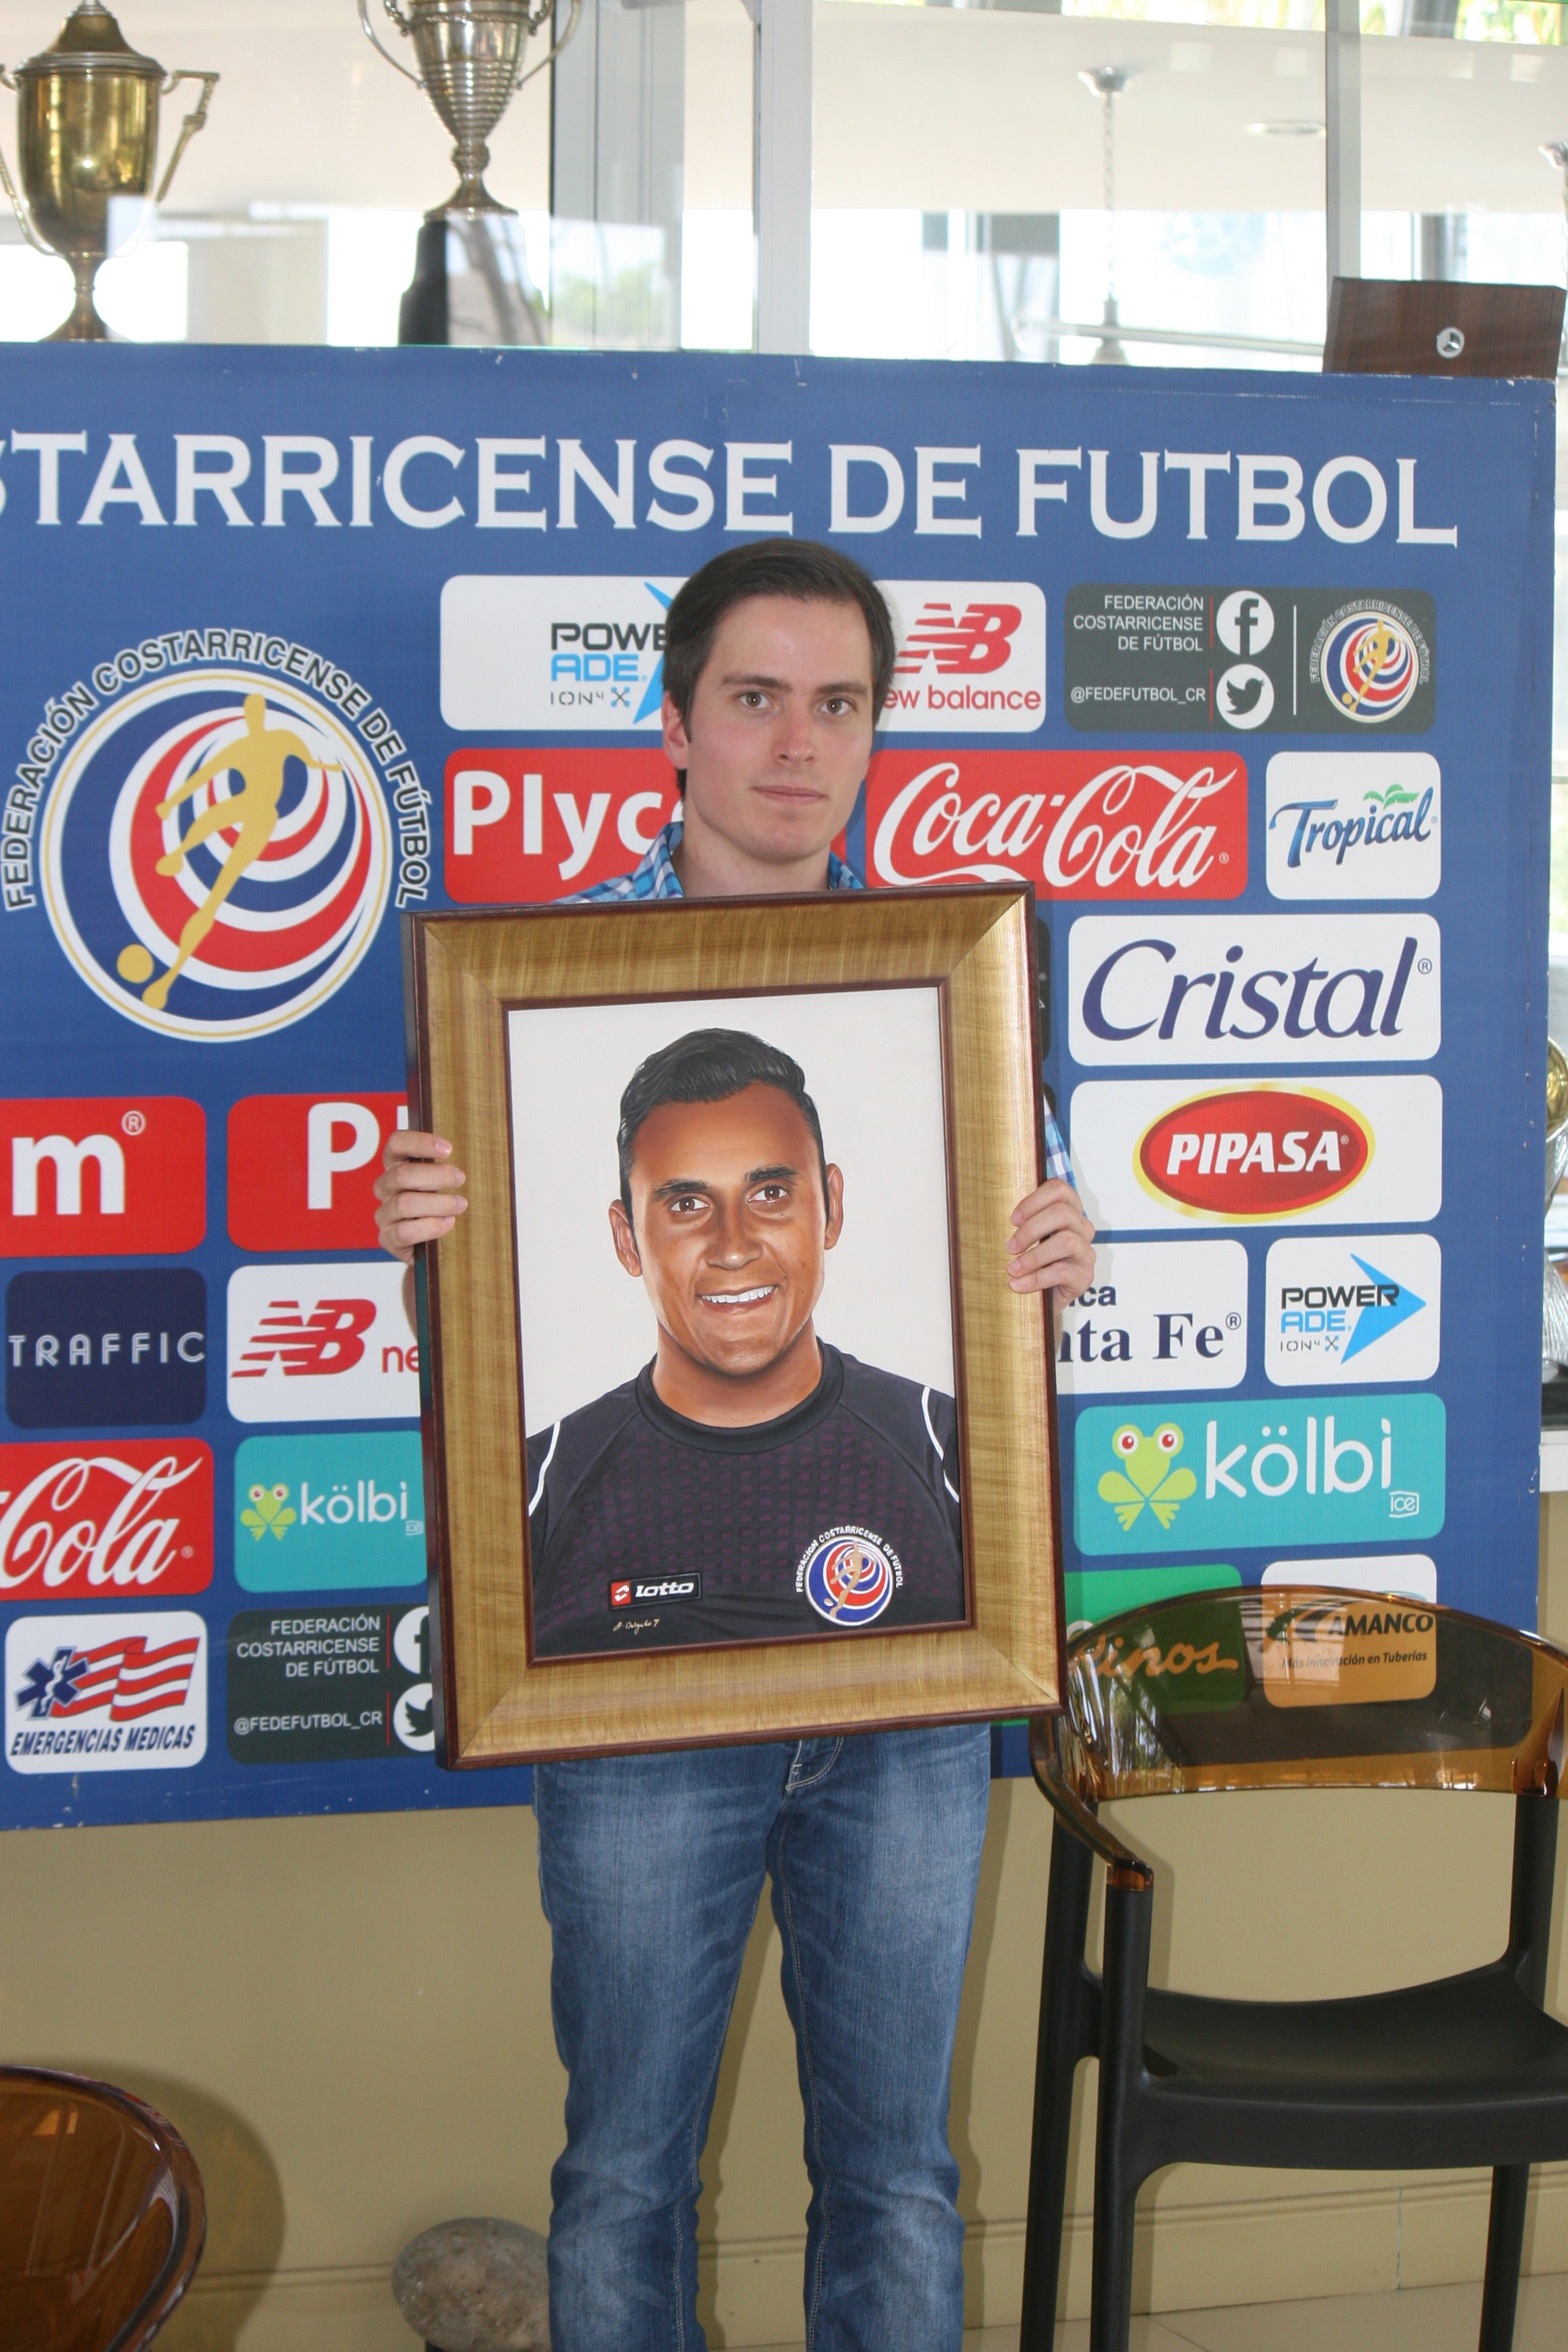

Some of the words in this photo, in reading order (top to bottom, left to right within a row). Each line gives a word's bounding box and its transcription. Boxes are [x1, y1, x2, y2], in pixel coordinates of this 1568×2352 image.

[0, 430, 793, 535] TARRICENSE
[828, 444, 981, 539] DE
[1016, 446, 1458, 548] FUTBOL
[1104, 593, 1204, 611] FEDERACIÓN
[1073, 614, 1204, 632] COSTARRICENSE
[1118, 636, 1139, 651] DE
[1142, 633, 1204, 652] FÚTBOL
[550, 653, 639, 682] ADE
[883, 689, 920, 709] ew
[928, 683, 1042, 710] balance
[1071, 685, 1206, 705] @FEDEFUTBOL_CR
[3, 683, 99, 912] FEDERACIÓN
[92, 627, 369, 720] COSTARRICENSE
[358, 708, 407, 763] DE
[386, 759, 434, 910] FÚTBOL
[452, 771, 682, 881] Plyc
[1269, 787, 1434, 869] Tropical
[1081, 936, 1418, 1041] Cristal
[1166, 1131, 1342, 1175] PIPASA
[1281, 1285, 1400, 1309] POWER
[1281, 1310, 1346, 1334] ADE
[9, 1332, 205, 1367] TRAFFIC
[1153, 1314, 1224, 1360] Fe
[1206, 1416, 1391, 1500] kölbi
[301, 1479, 408, 1526] kölbi
[818, 1525, 883, 1546] COSTARRICENSE
[635, 1582, 694, 1598] lotto
[270, 1613, 381, 1636] FEDERACIÓN
[1327, 1612, 1434, 1637] AMANCO
[236, 1637, 380, 1659] COSTARRICENSE
[1367, 1654, 1380, 1664] en
[1383, 1649, 1428, 1663] Tuberías
[285, 1661, 309, 1677] DE
[313, 1657, 380, 1676] FÚTBOL
[234, 1712, 383, 1735] @FEDEFUTBOL_CR
[9, 1728, 122, 1757] EMERGENCIAS
[124, 1724, 196, 1752] MEDICAS
